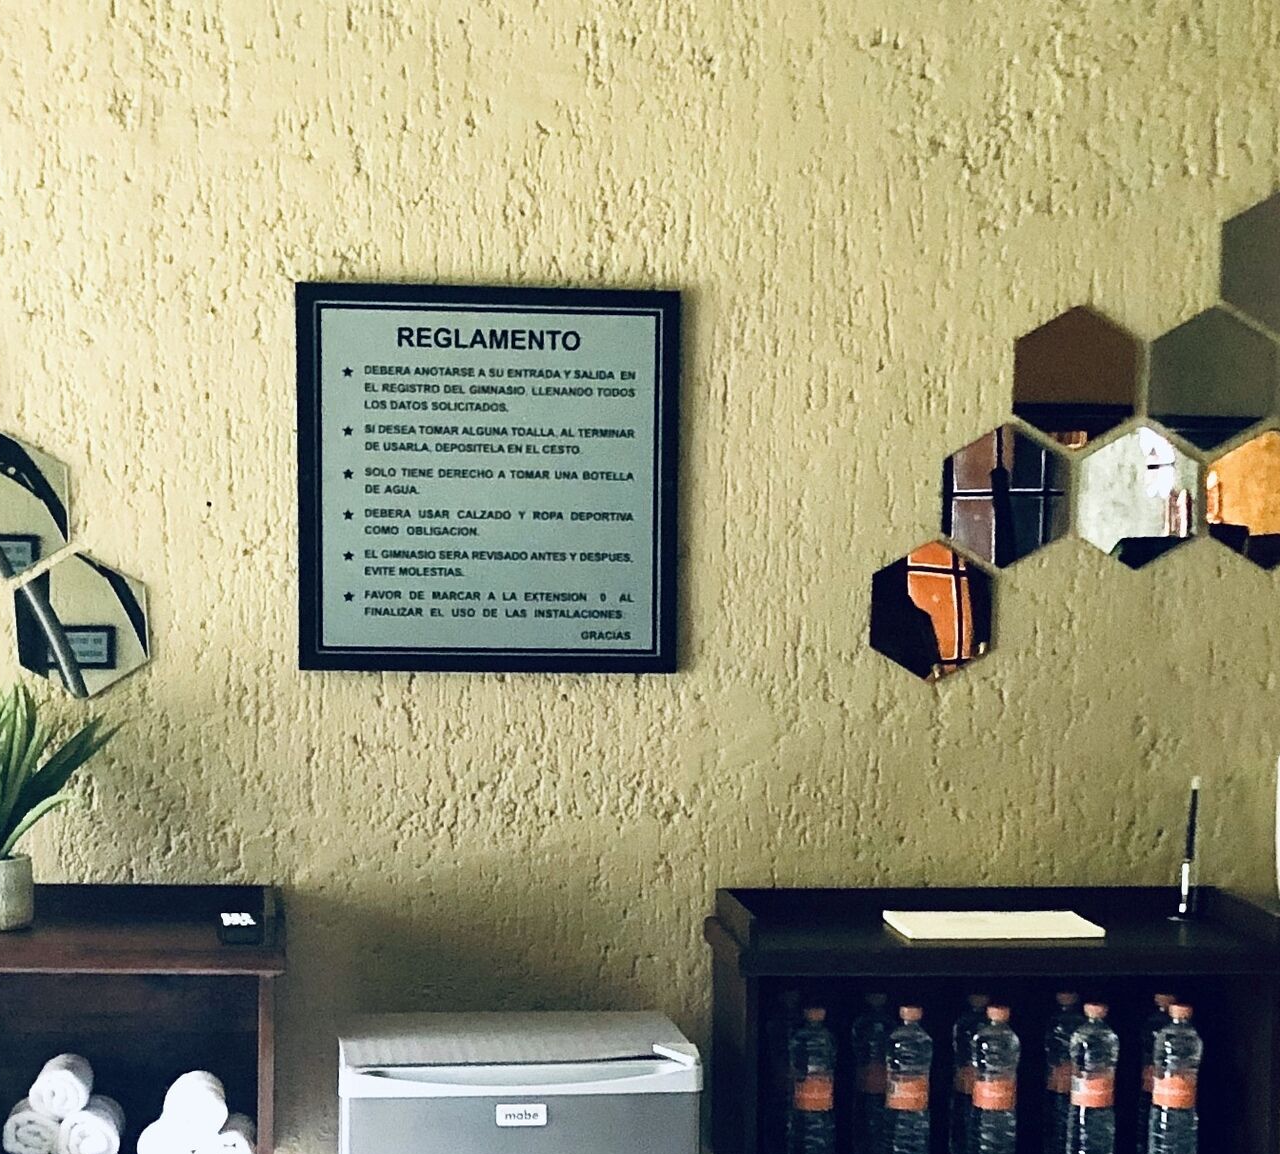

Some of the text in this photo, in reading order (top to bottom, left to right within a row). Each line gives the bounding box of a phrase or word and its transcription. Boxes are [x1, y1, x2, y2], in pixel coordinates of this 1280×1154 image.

[396, 327, 582, 351] REGLAMENTO
[364, 365, 636, 380] DEBERA ANOTARSE A SU ENTRADA Y SALIDA EN
[364, 383, 378, 392] EL
[382, 383, 440, 393] REGISTRO
[444, 384, 465, 394] DEL
[532, 387, 593, 397] LLENANDO
[597, 388, 636, 397] TODOS
[364, 400, 387, 409] LOS
[390, 401, 428, 410] DATOS
[365, 424, 375, 433] SI
[379, 425, 416, 434] DESEA
[419, 426, 458, 435] TOMAR
[462, 426, 508, 436] ALGUNA
[560, 428, 574, 437] AL
[578, 428, 635, 438] TERMINAR
[365, 442, 379, 451] DE
[435, 443, 505, 453] DEPOSITELA
[508, 444, 522, 453] EN
[526, 445, 539, 454] EL
[365, 467, 634, 481] SOLO TIENE DERECHO A TOMAR UNA BOTELLA
[365, 485, 380, 494] DE
[365, 509, 634, 521] DEBERA USAR CALZADO Y ROPA DEPORTIVA
[365, 526, 399, 534] COMO
[364, 550, 378, 558] EL
[381, 550, 435, 559] GIMNASIO
[439, 551, 468, 560] SERA
[472, 551, 528, 560] REVISADO
[530, 552, 566, 561] ANTES
[569, 552, 577, 561] Y
[364, 567, 395, 576] EVITE
[364, 590, 402, 599] FAVOR
[409, 591, 424, 600] DE
[432, 591, 481, 601] MARCAR
[488, 592, 495, 600] A
[503, 592, 517, 601] LA
[524, 592, 587, 602] EXTENSION
[619, 593, 634, 602] AL
[364, 607, 423, 616] FINALIZAR
[431, 608, 444, 617] EL
[452, 608, 475, 617] USO
[483, 609, 498, 617] DE
[505, 609, 527, 618] LAS
[581, 631, 631, 640] GRACIAS
[504, 1110, 540, 1120] mabe
